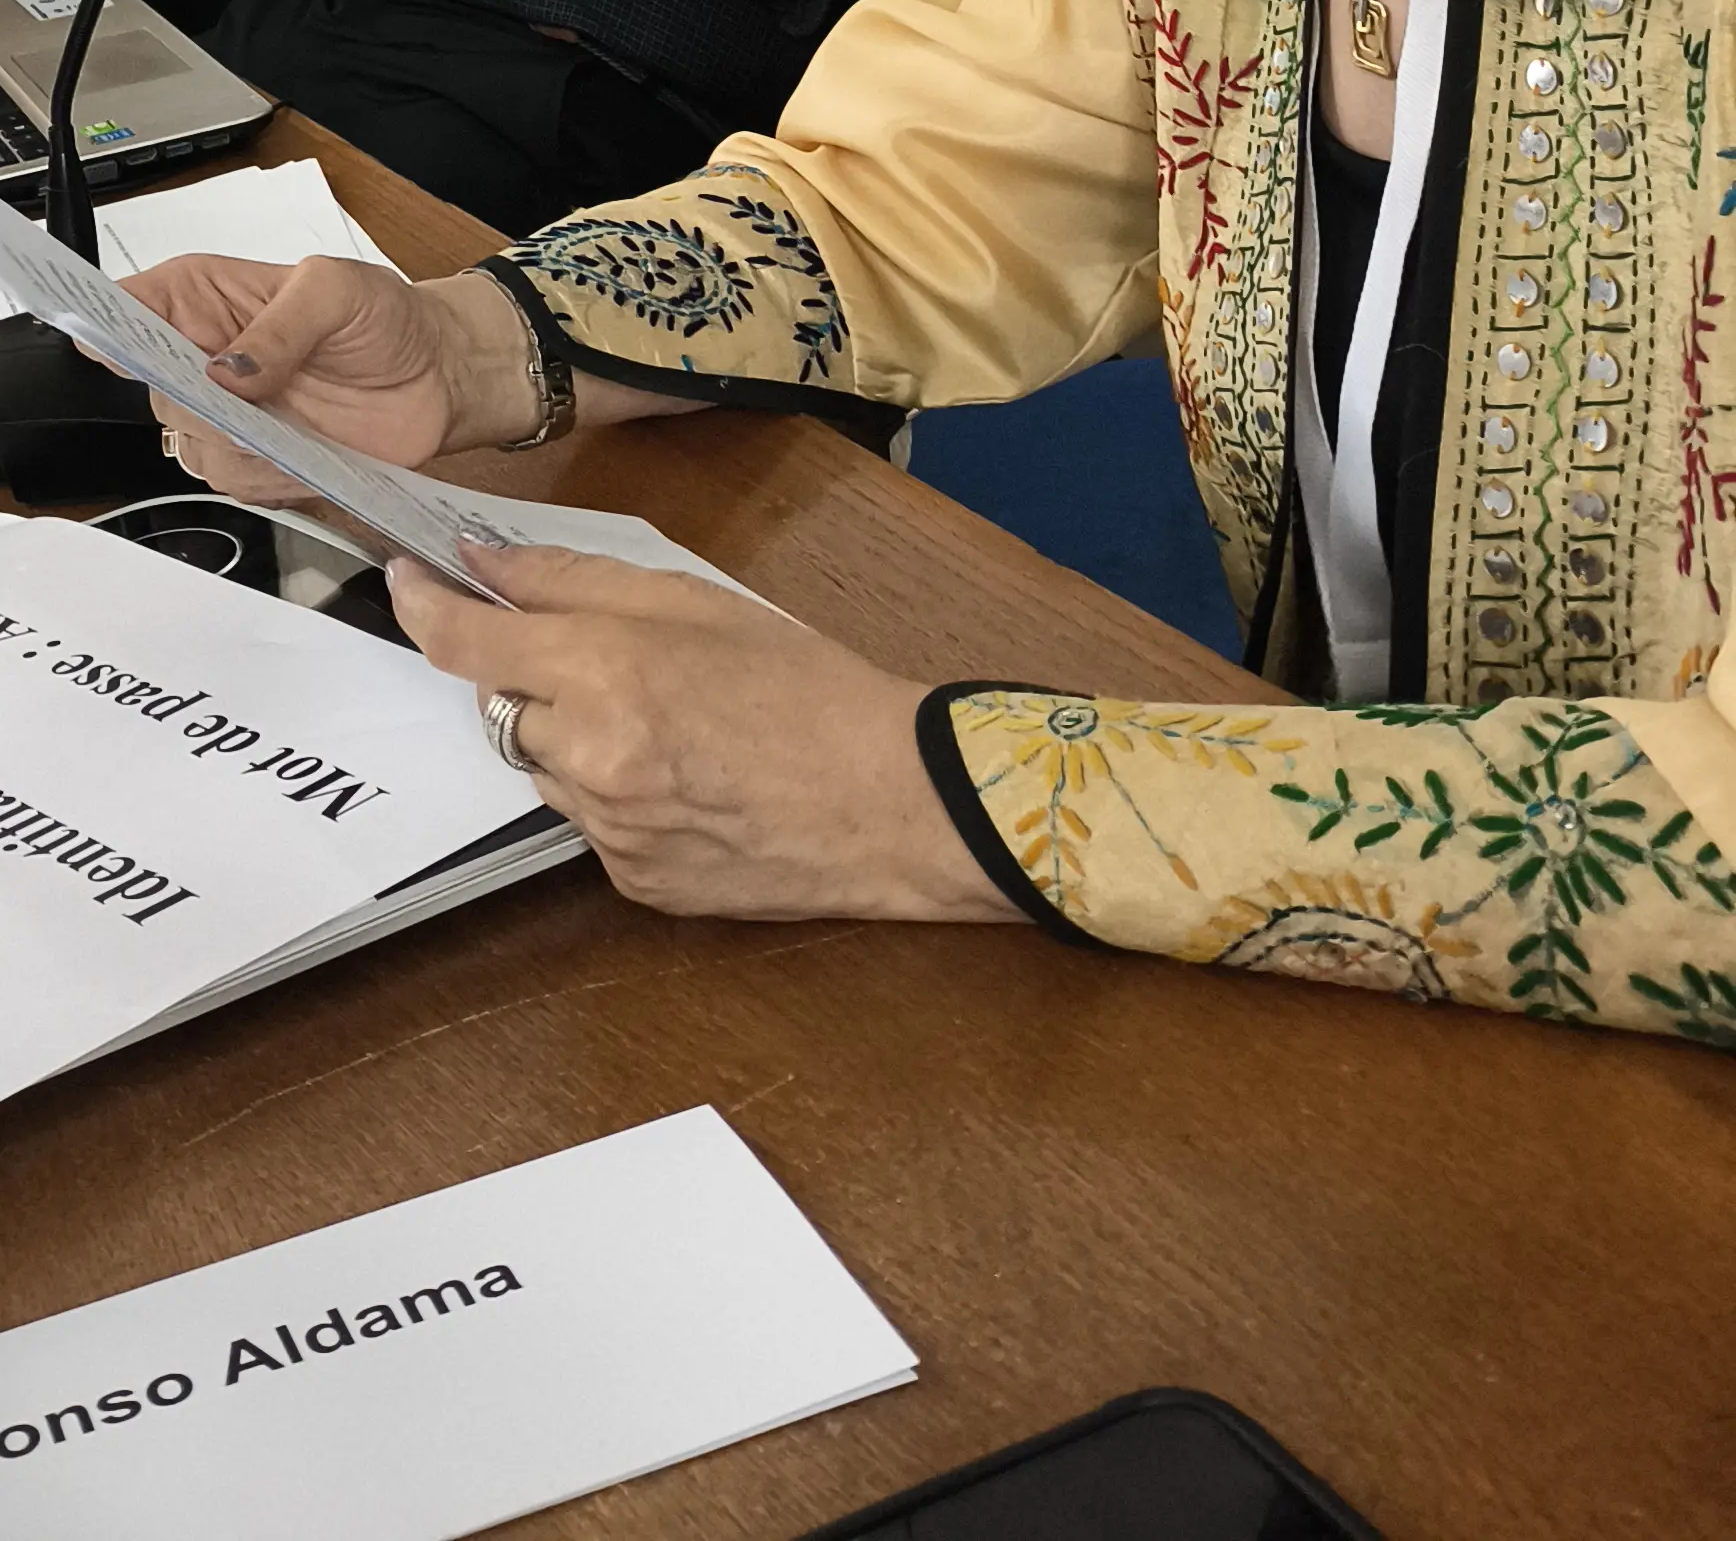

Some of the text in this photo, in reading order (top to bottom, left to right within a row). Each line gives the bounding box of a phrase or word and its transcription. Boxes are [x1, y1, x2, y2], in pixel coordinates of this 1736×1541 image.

[51, 653, 213, 723] passe
[183, 714, 261, 759] de
[241, 747, 391, 823] Mot
[222, 1263, 524, 1387] Aldama
